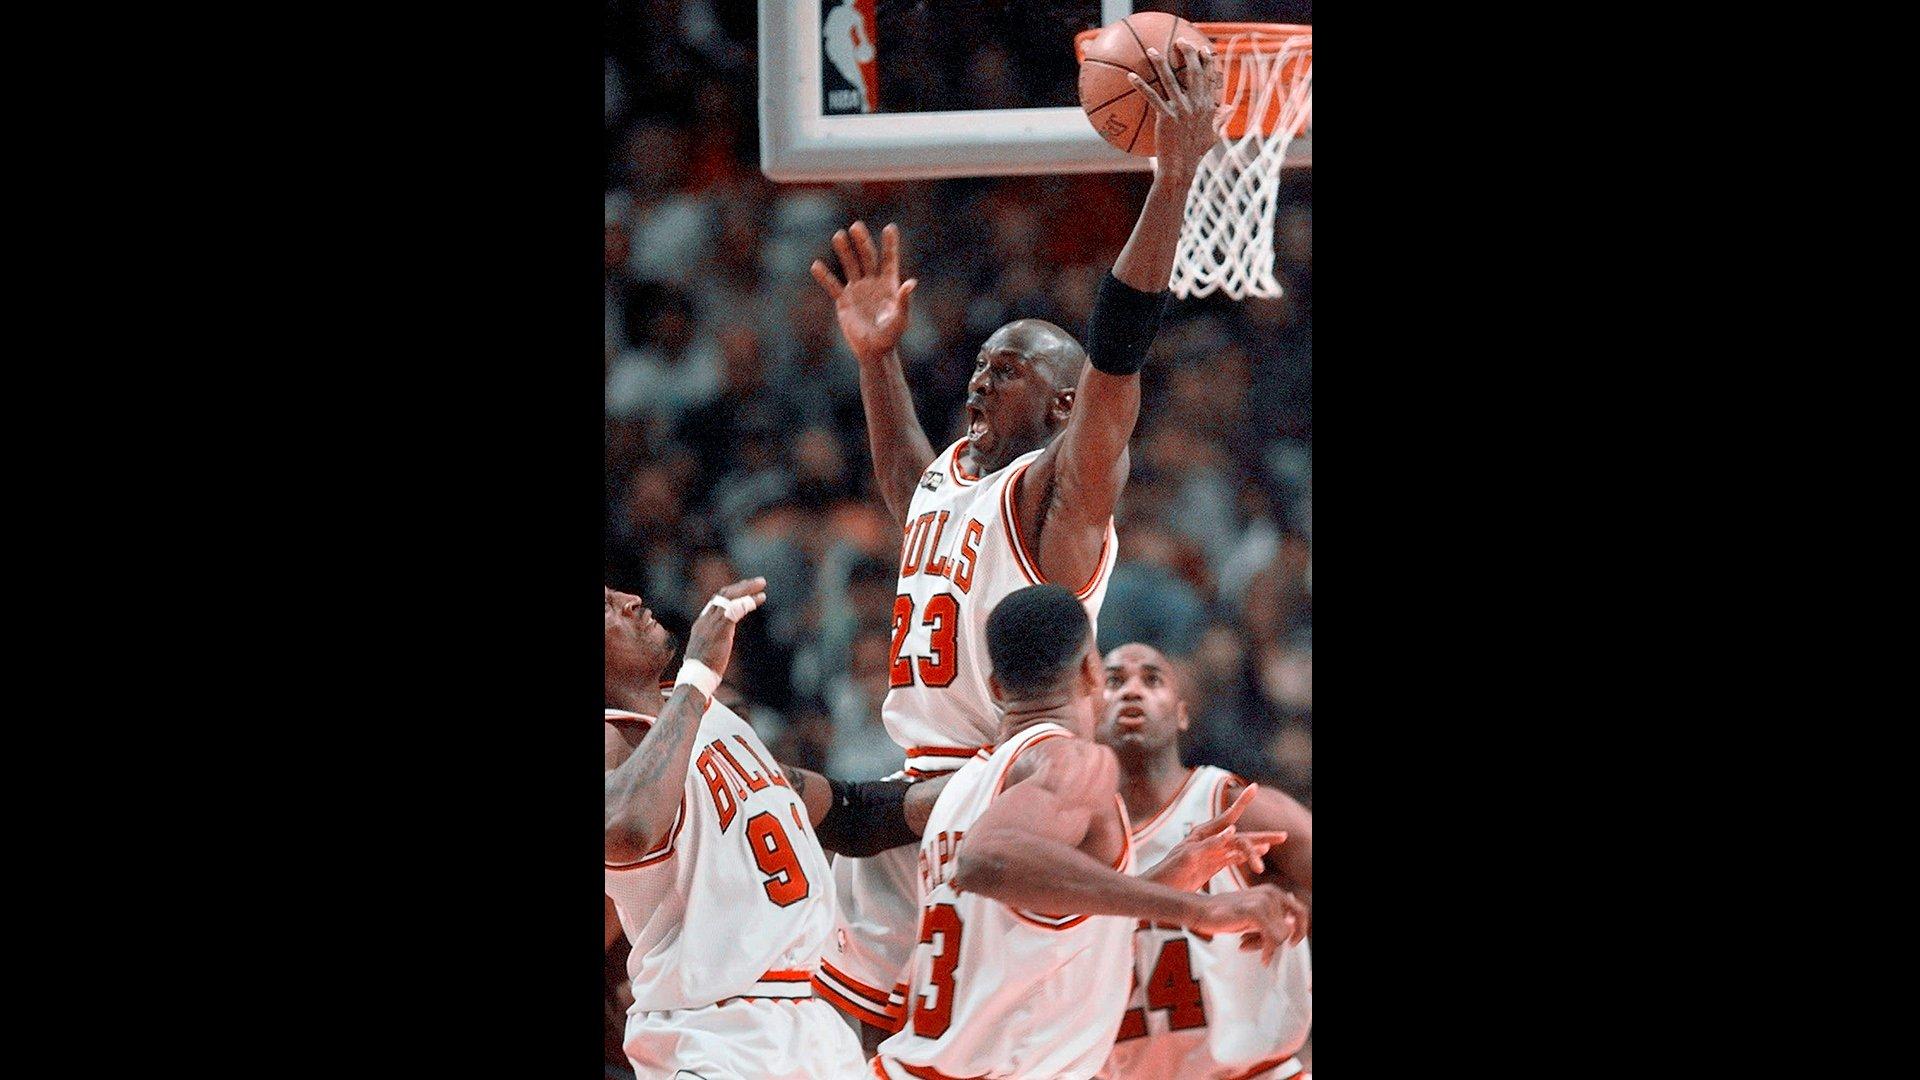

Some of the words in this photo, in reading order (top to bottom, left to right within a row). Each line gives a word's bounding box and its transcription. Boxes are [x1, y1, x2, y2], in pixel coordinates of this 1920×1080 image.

[899, 510, 985, 595] ULS
[889, 592, 960, 689] 23
[745, 802, 809, 908] 9
